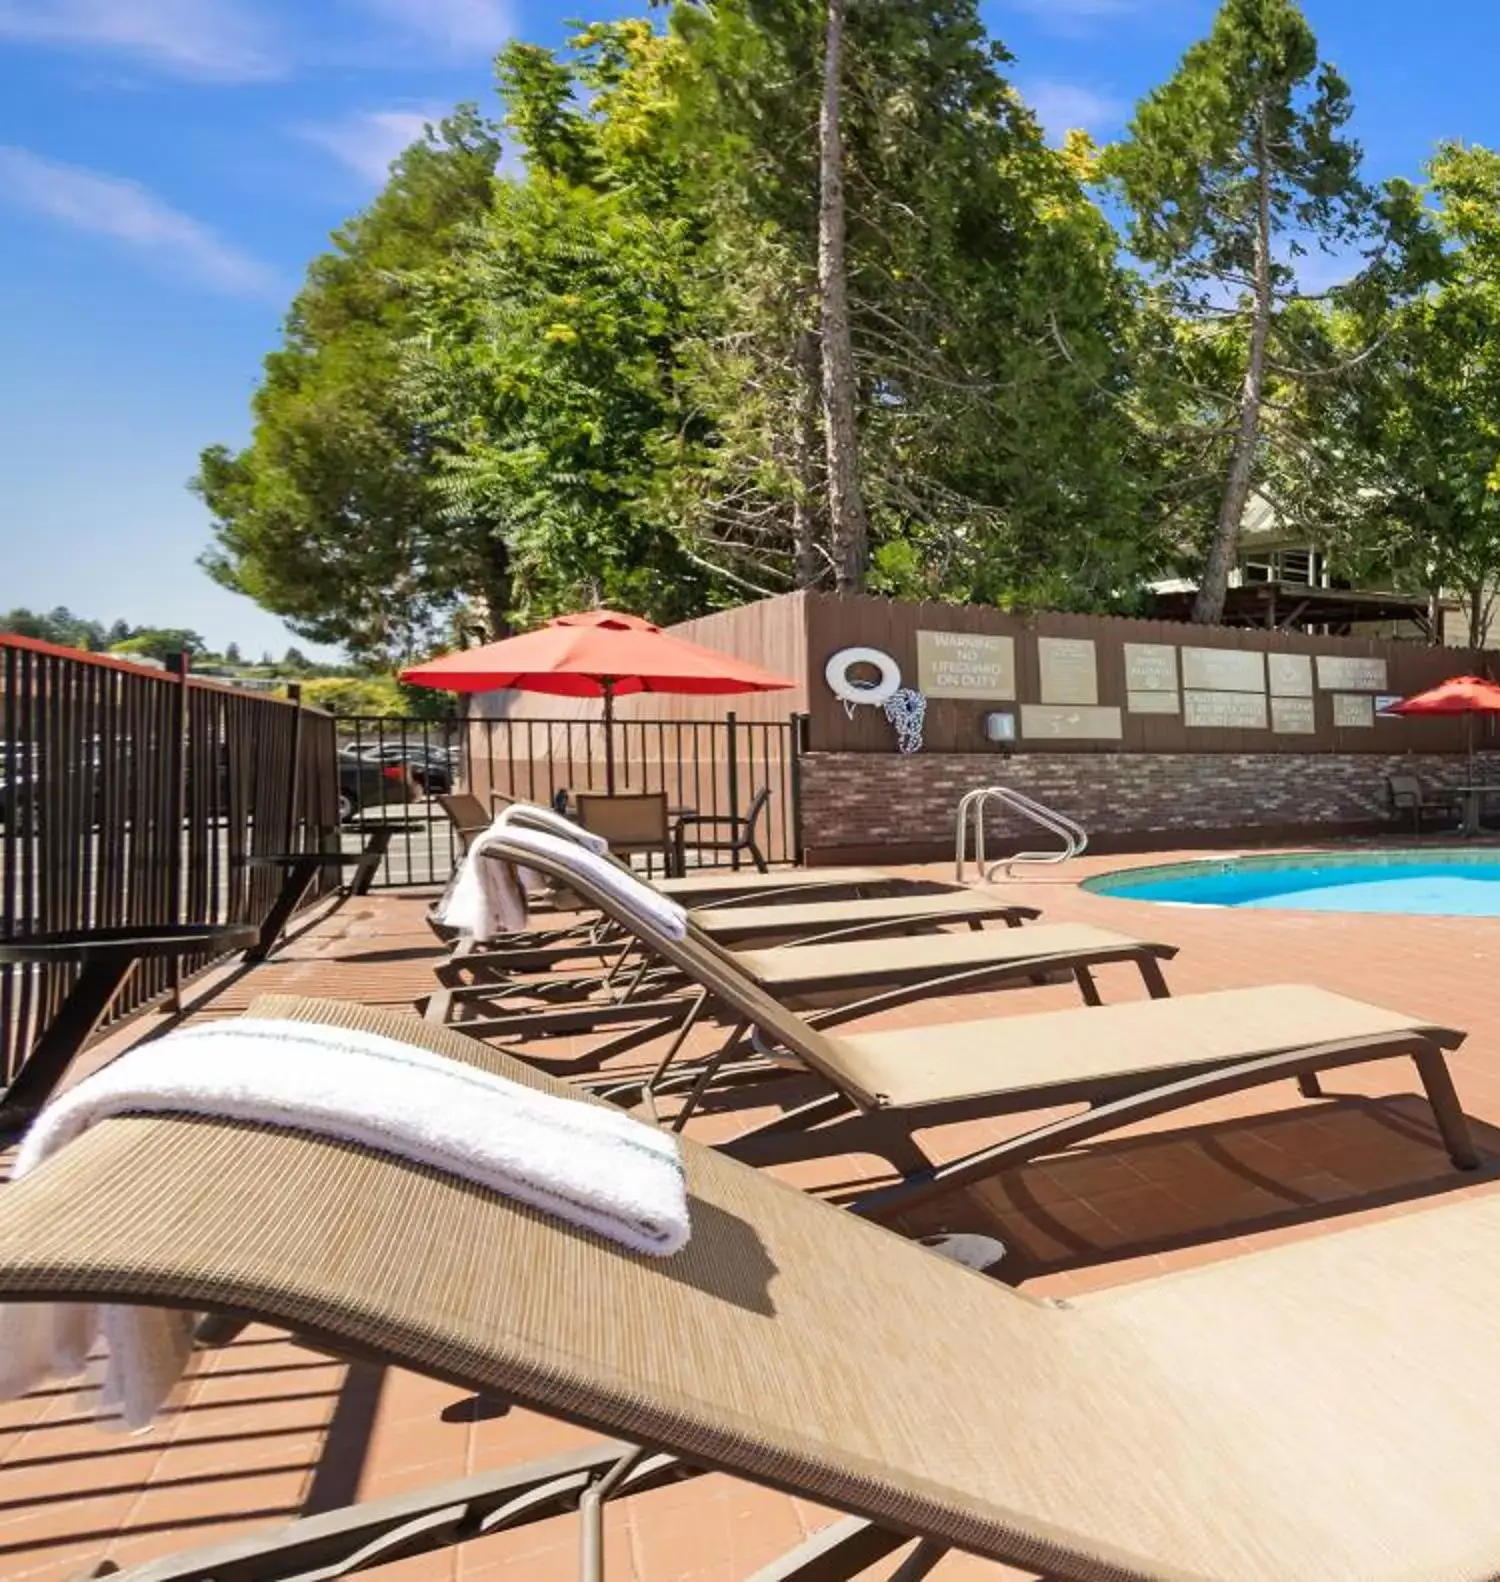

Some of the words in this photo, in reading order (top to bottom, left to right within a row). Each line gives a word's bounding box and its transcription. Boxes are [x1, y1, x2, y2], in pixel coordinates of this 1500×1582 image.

[934, 632, 998, 651] WARNING
[957, 649, 978, 660] NO
[932, 661, 1001, 675] LIFEGUARD
[937, 673, 959, 686] ON
[962, 674, 998, 688] DUTY
